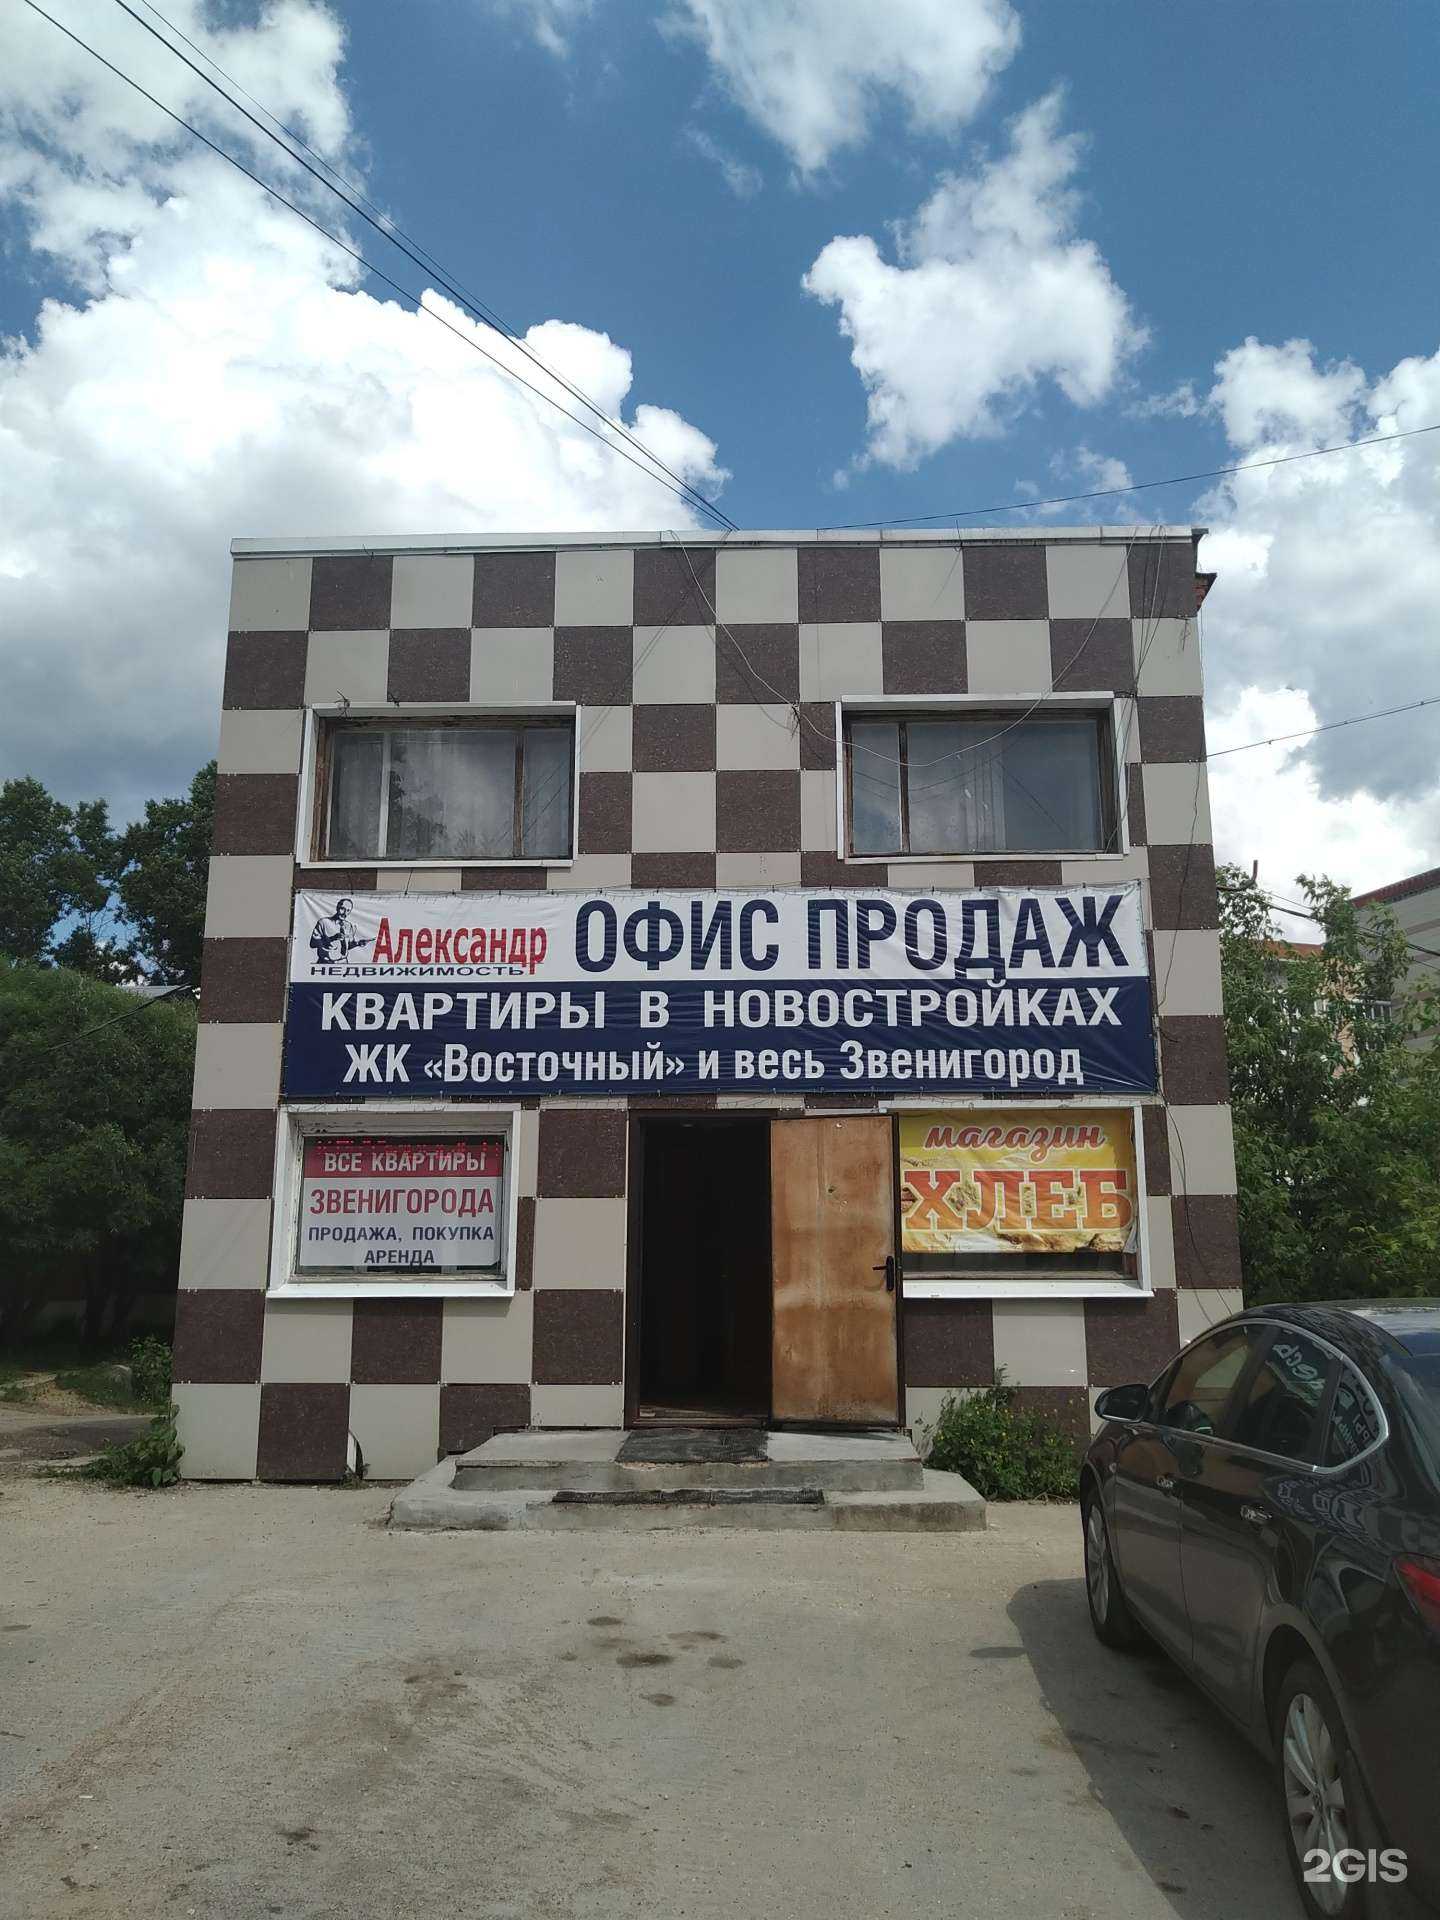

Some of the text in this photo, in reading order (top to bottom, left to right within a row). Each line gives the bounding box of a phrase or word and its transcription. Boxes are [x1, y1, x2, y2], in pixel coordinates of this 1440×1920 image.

[372, 917, 547, 975] Александр
[575, 894, 1129, 980] ОФИС ПРОДАЖ
[310, 964, 525, 978] НЕДВИЖИМОСТЬ
[321, 979, 1121, 1031] КВАРТИРЫ В НОВОСТРОЙКАХ
[343, 1040, 1083, 1087] ЖК «Восточный» и весь Звенигород
[324, 1151, 486, 1172] ВСЕ КВАРТИРЫ
[923, 1125, 1107, 1163] магазин
[310, 1188, 494, 1217] ЗВЕНИГОРОДА
[902, 1168, 1133, 1231] ХЛЕБ
[308, 1226, 494, 1243] ПРОДАЖА, ПОКУПКА
[364, 1250, 435, 1267] АРЕНДА
